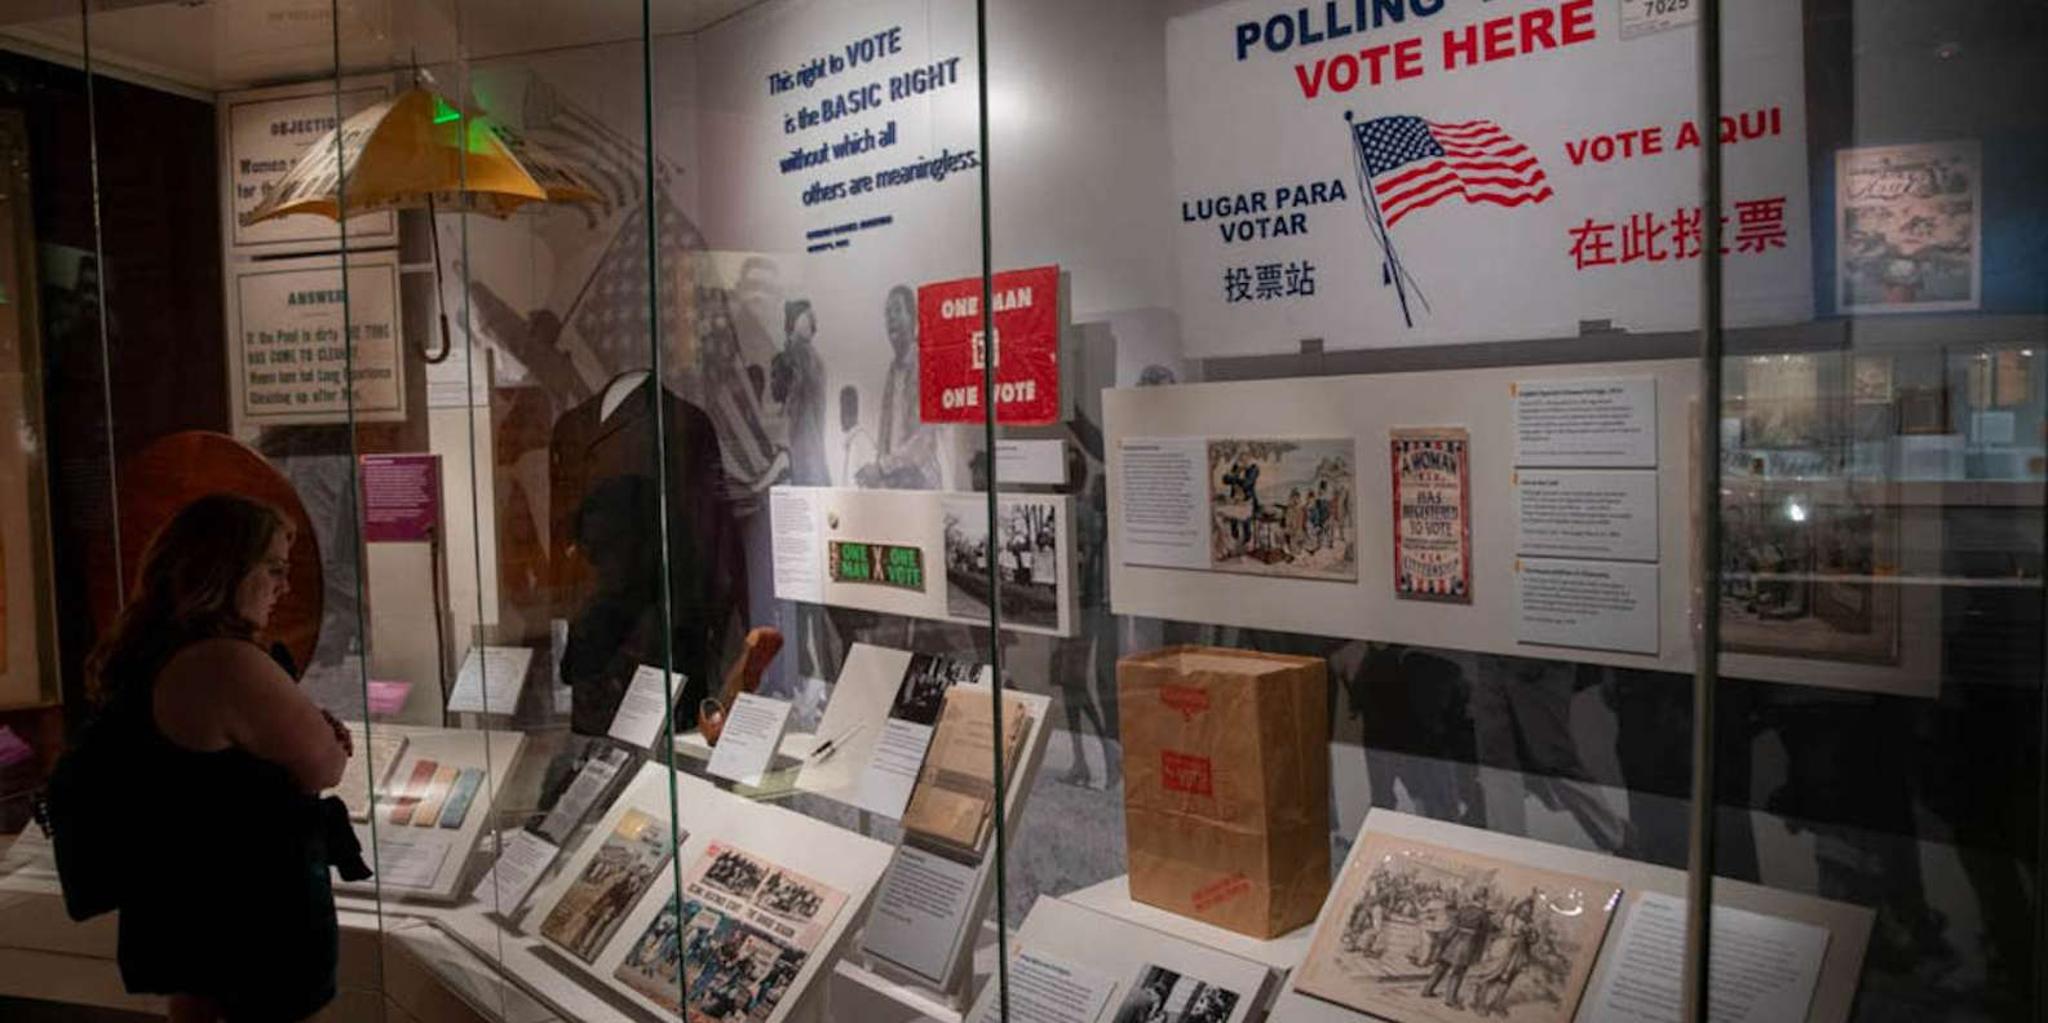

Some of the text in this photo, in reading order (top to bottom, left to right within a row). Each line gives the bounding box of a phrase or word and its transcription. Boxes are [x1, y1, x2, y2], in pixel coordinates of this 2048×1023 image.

[768, 26, 902, 96] This right to VOTE
[1295, 0, 1596, 100] VOTE HERE
[784, 57, 960, 134] is the BASIC RIGHT
[779, 121, 896, 174] without which all
[1565, 127, 1662, 166] VOTE
[802, 181, 847, 207] others
[849, 174, 873, 197] are
[1182, 179, 1347, 222] LUGAR PARA
[1220, 213, 1307, 243] VOTAR
[1224, 260, 1316, 303] 投票站
[941, 296, 978, 319] ONE
[942, 385, 978, 409] ONE
[1411, 451, 1457, 474] WOMAN
[1417, 490, 1441, 504] HAS
[1410, 521, 1452, 537] TO VOTE
[842, 543, 868, 560] ONE
[890, 547, 916, 566] ONE
[842, 561, 921, 586] MAN VOTE
